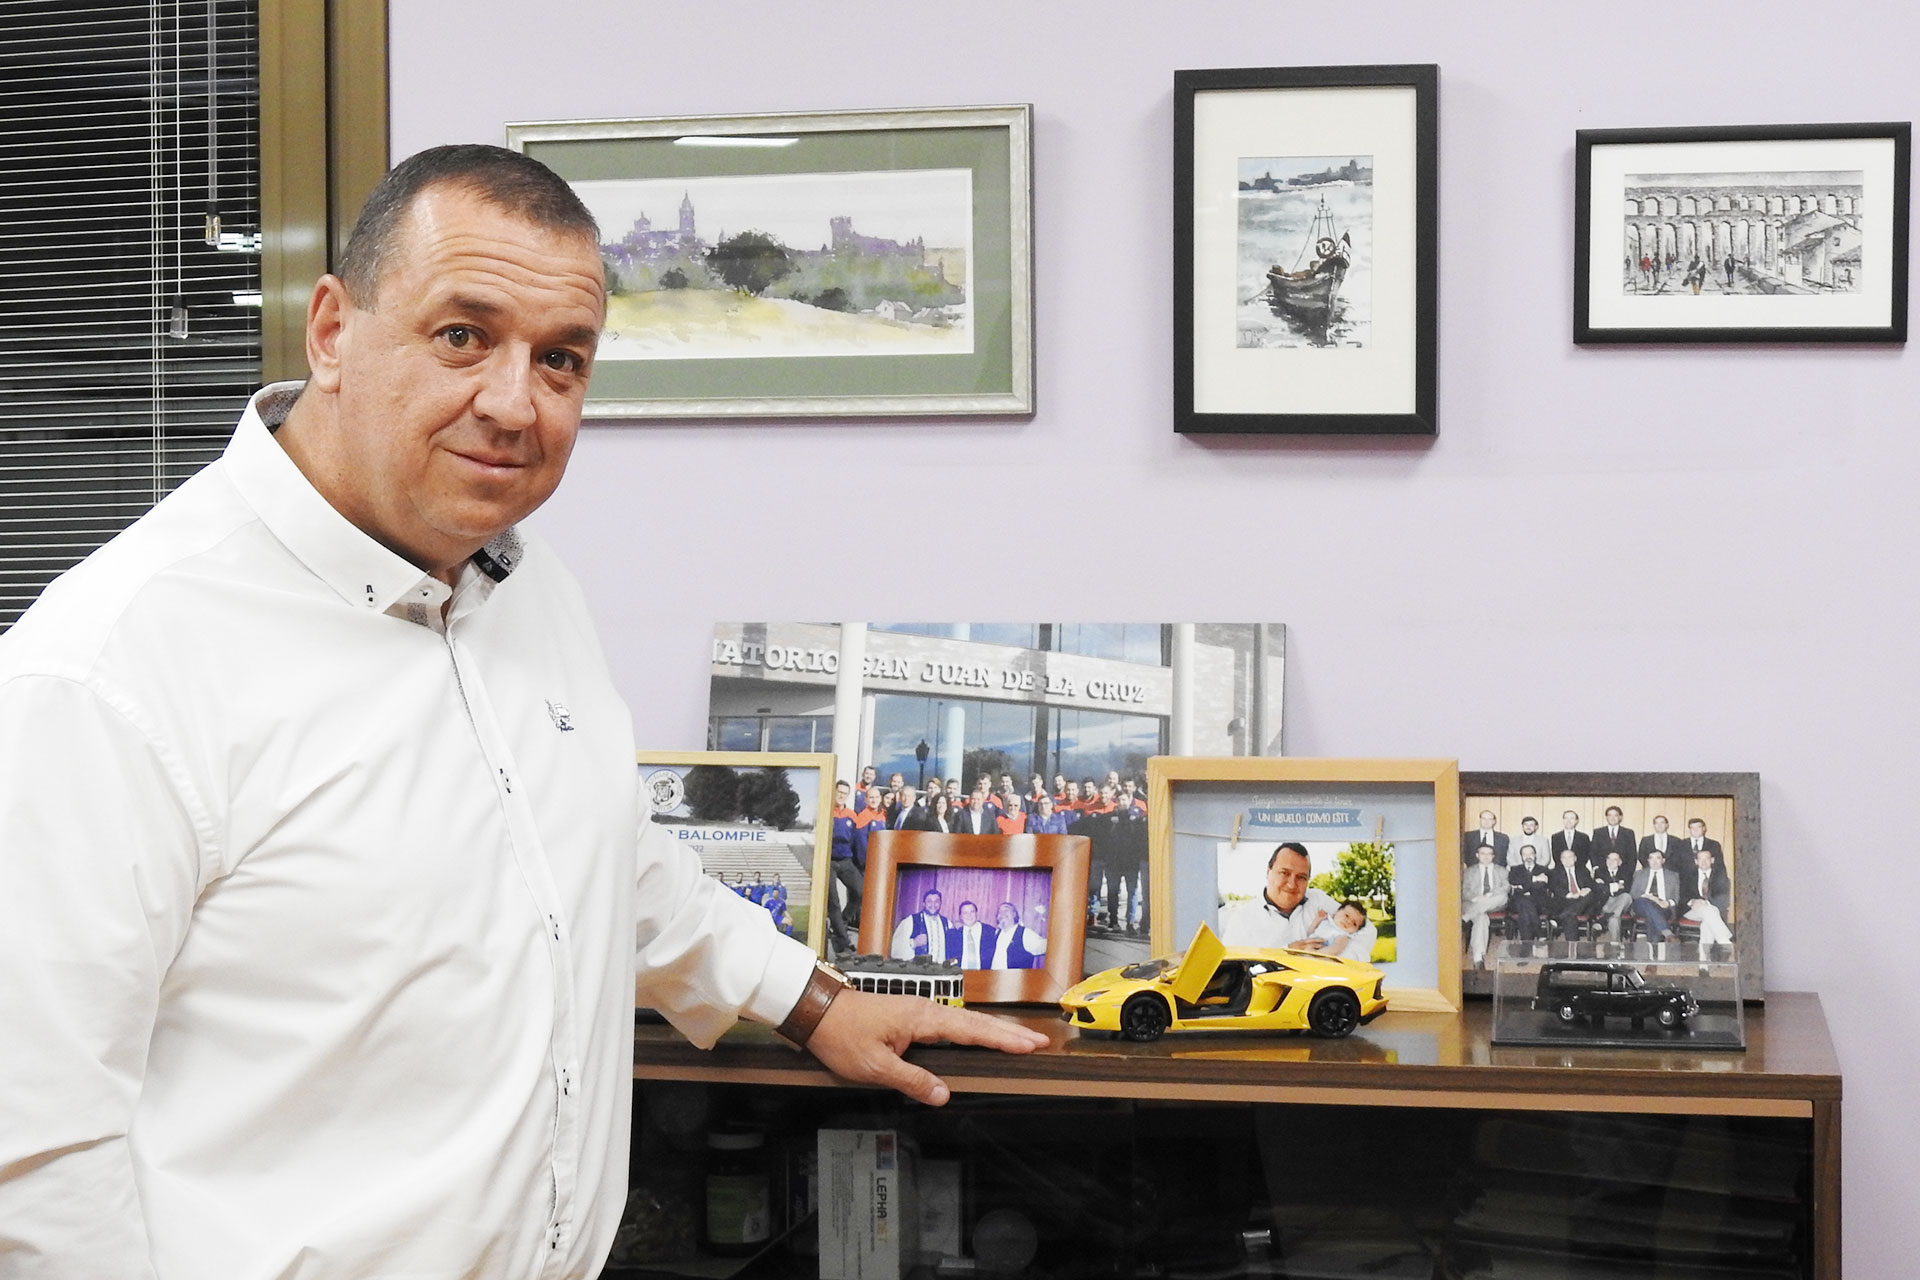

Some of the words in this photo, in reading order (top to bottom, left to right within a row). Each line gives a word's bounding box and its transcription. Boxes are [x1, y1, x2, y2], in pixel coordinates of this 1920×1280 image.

[862, 652, 911, 680] SAN
[920, 662, 990, 688] JUAN
[1002, 670, 1035, 692] DE
[1044, 674, 1076, 697] LA
[1086, 679, 1145, 703] CRUZ
[1257, 812, 1271, 823] UN
[1274, 812, 1302, 824] ABUELO
[1305, 812, 1331, 824] COMO
[678, 829, 767, 842] BALOMPIE
